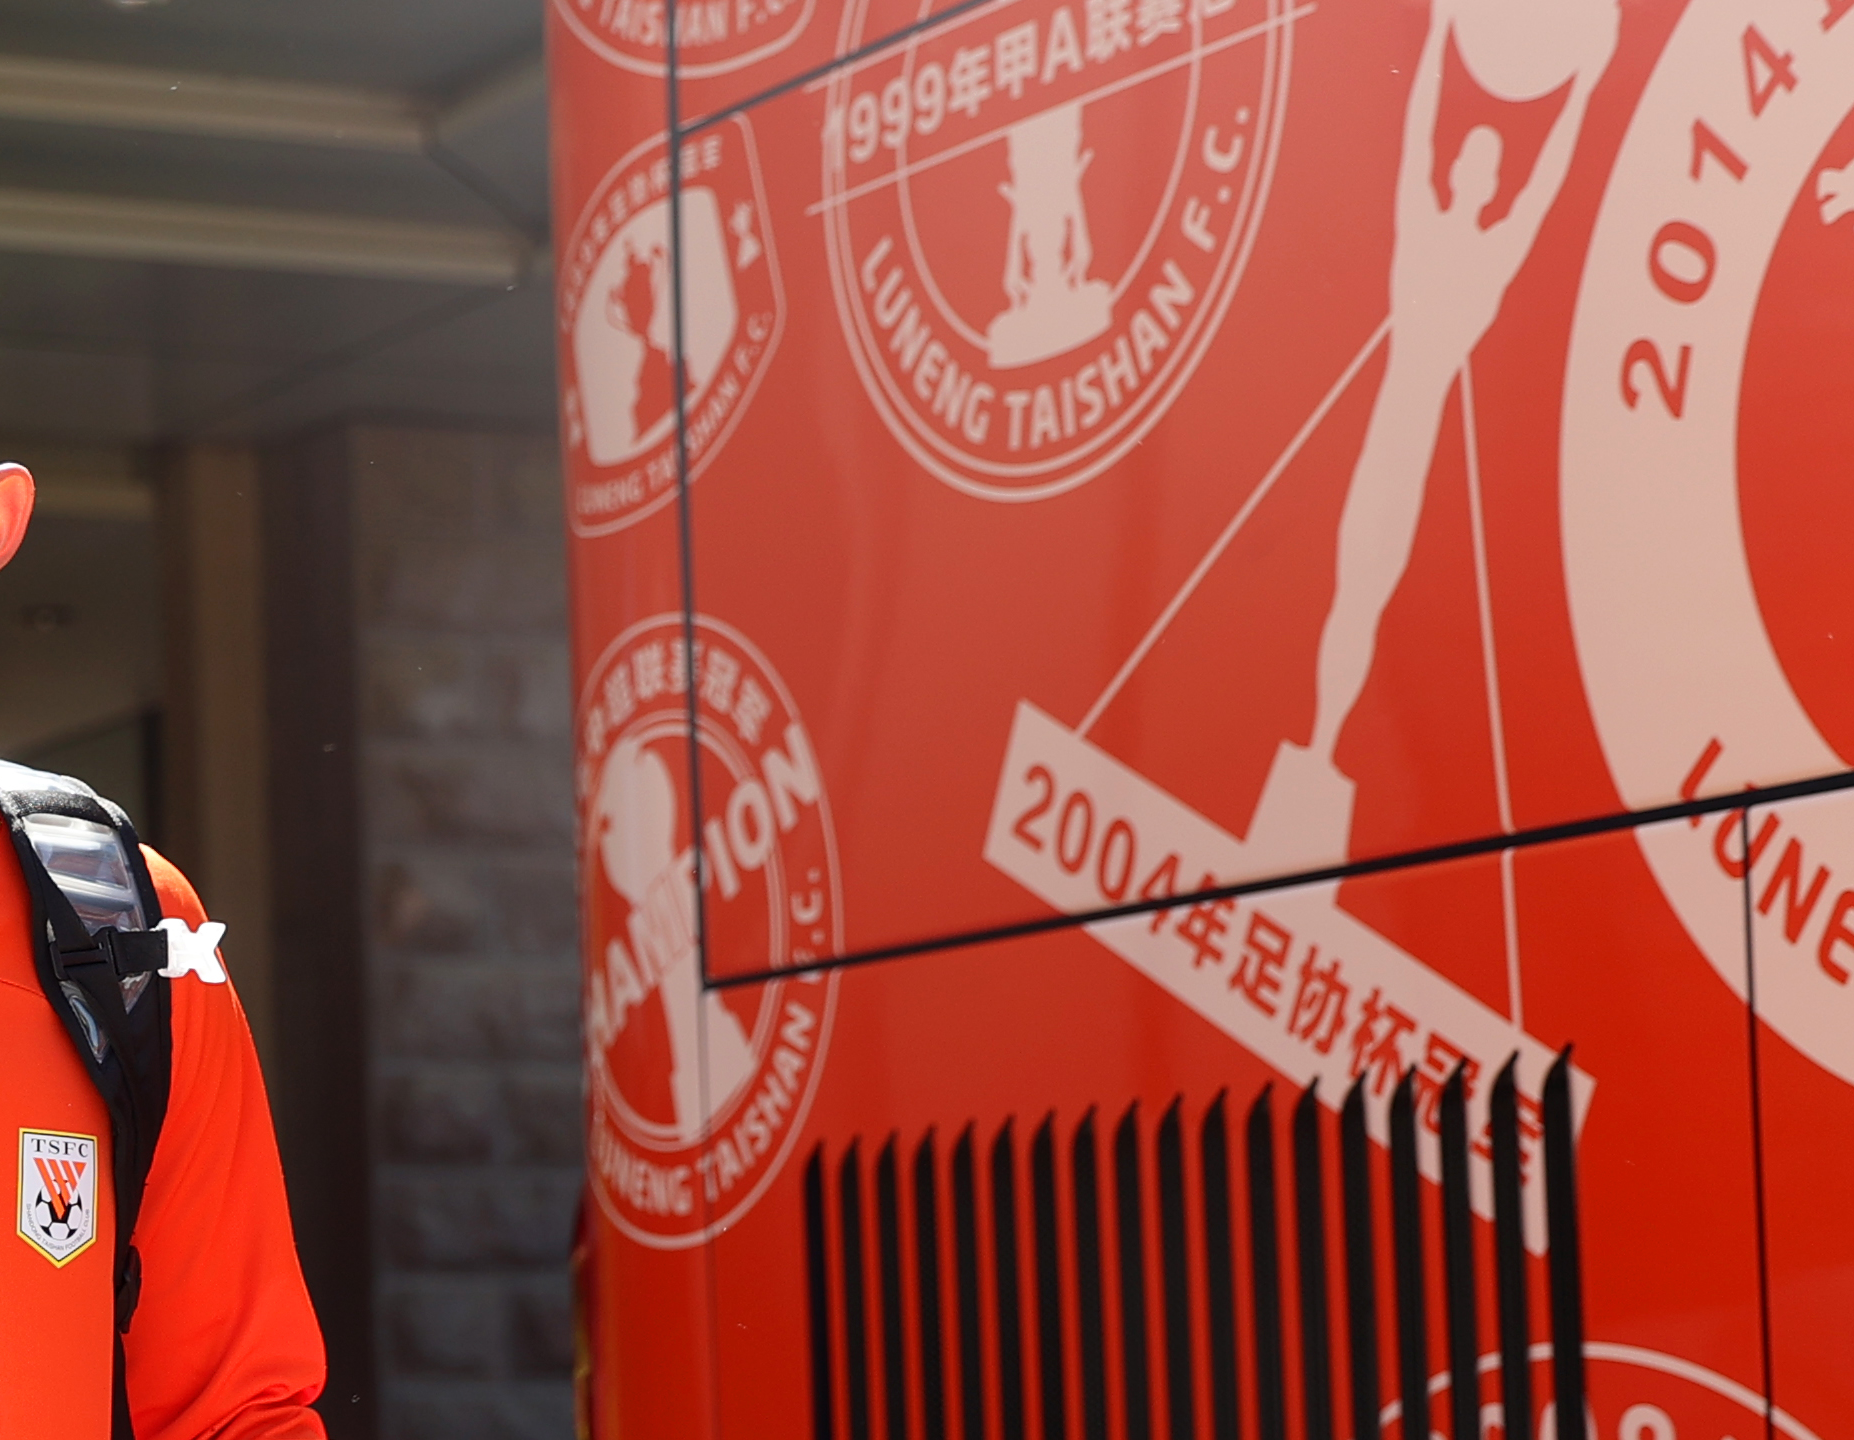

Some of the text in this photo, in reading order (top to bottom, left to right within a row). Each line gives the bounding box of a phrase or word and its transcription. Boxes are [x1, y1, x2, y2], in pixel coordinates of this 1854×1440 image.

[859, 104, 1250, 450] LUNENG TAISHAN F.C.
[31, 1138, 88, 1158] TSFC
[697, 1002, 815, 1202] TAISHAN
